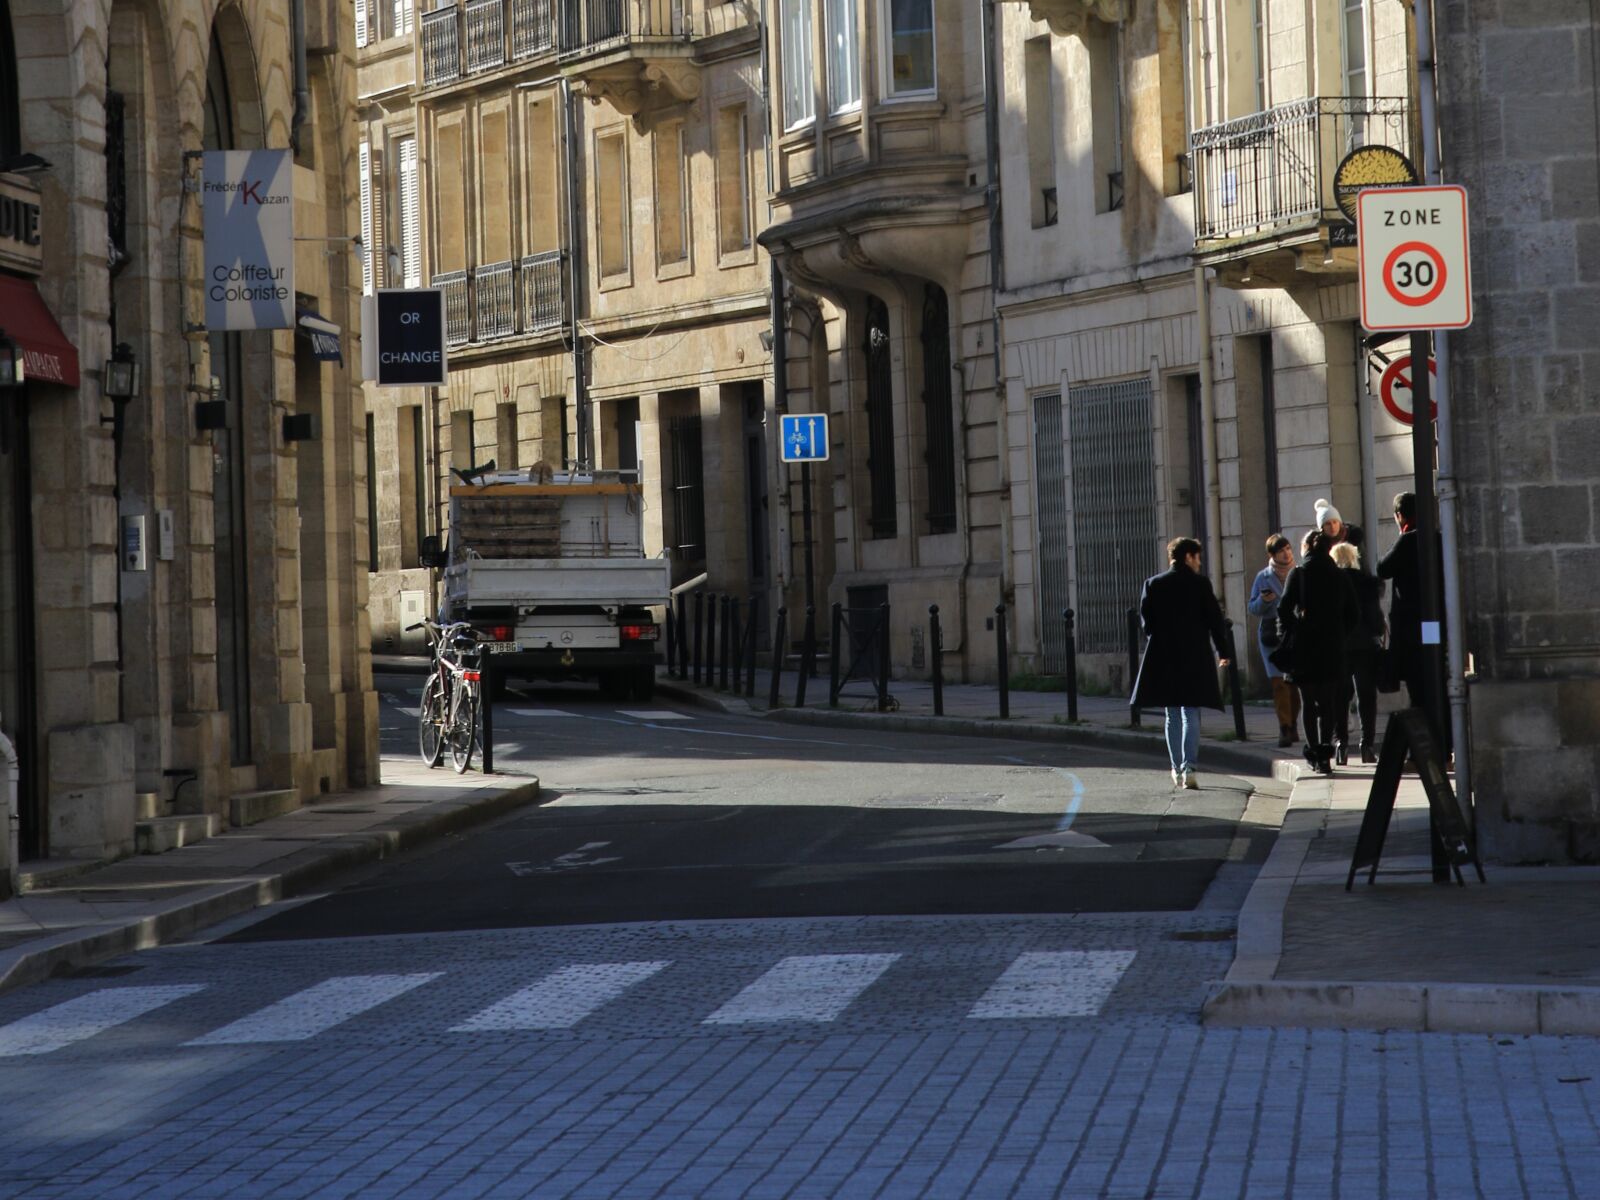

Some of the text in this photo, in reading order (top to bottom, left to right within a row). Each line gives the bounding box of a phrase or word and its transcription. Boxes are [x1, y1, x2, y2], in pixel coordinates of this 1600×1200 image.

[1384, 209, 1441, 226] ZONE
[213, 265, 285, 281] Coiffeur
[1396, 261, 1434, 287] 30
[210, 285, 288, 301] Coloriste
[400, 312, 420, 324] OR
[381, 351, 440, 364] CHANGE
